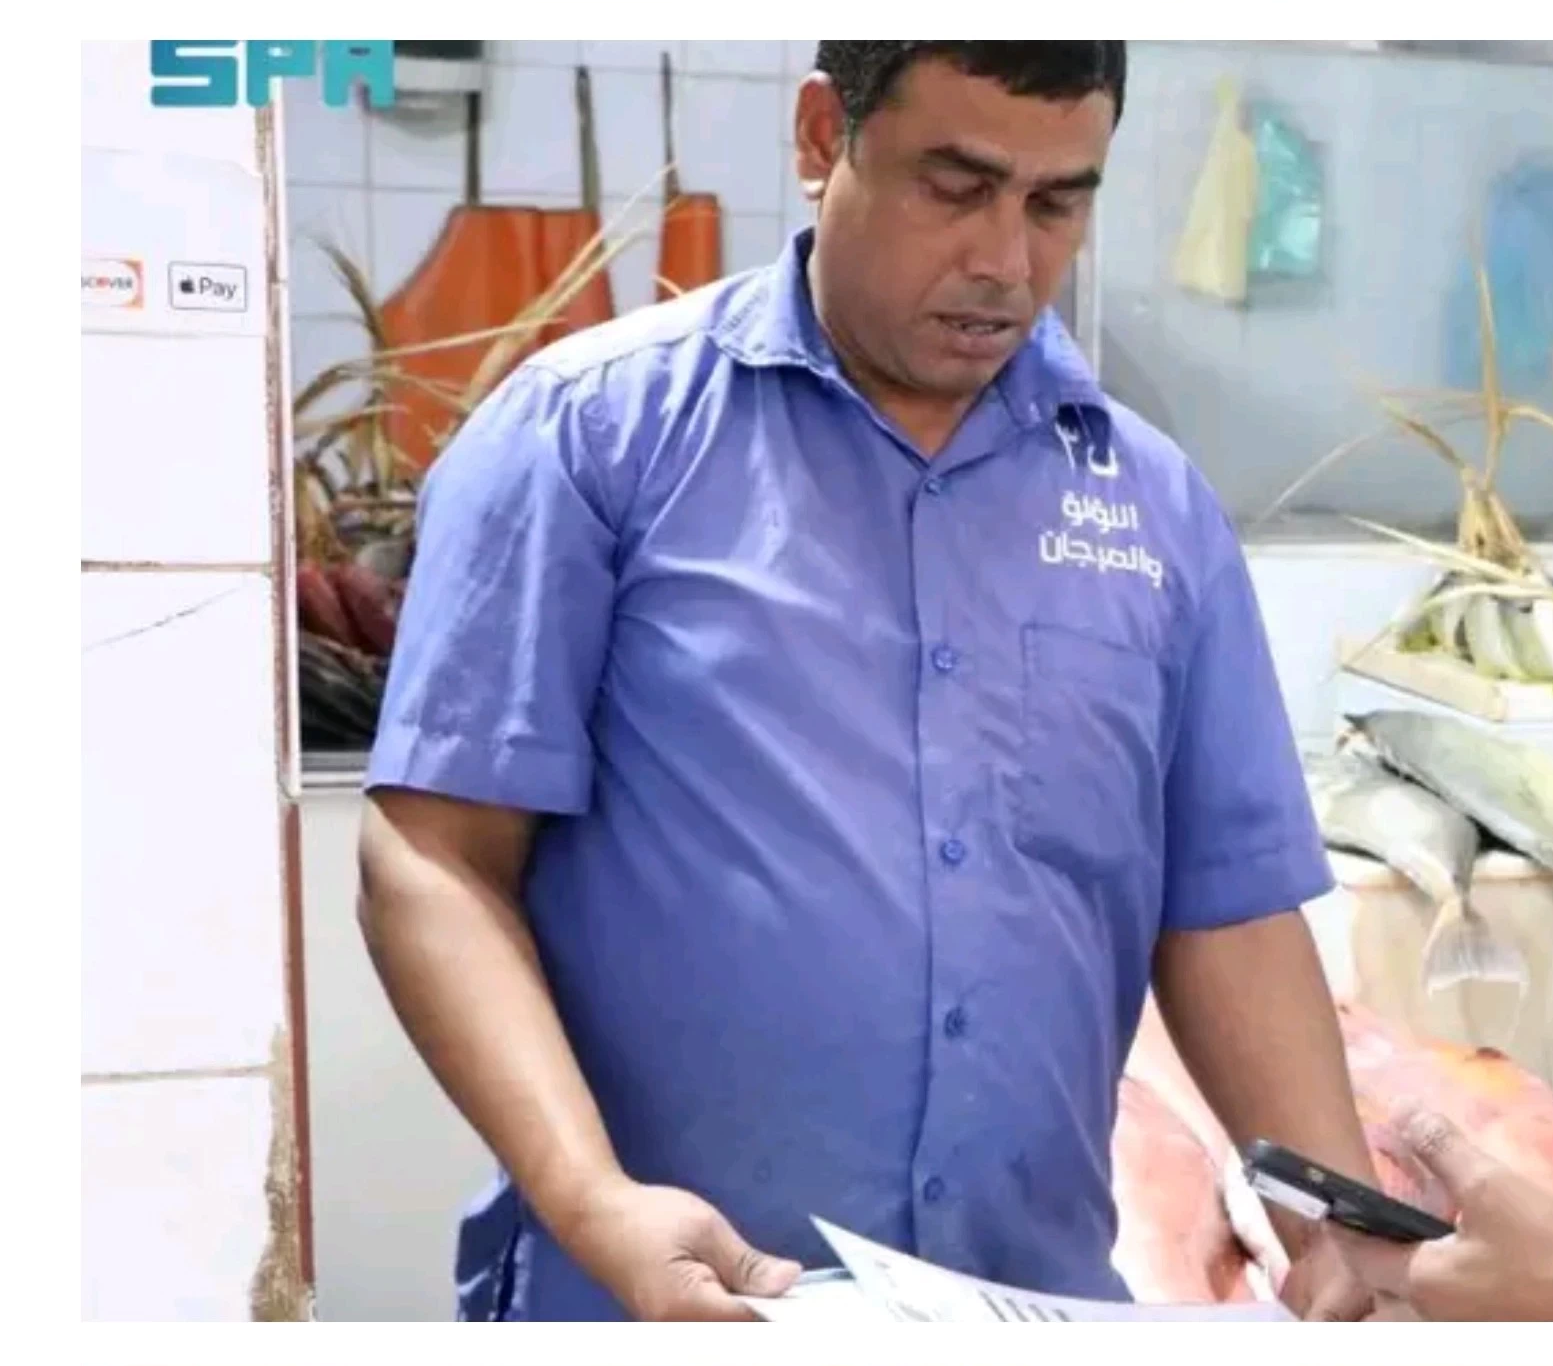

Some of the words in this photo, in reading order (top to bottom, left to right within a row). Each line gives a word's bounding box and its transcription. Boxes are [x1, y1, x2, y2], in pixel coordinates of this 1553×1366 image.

[199, 276, 237, 300] Pay
[1062, 489, 1138, 533] اللؤلؤ
[1039, 530, 1162, 588] والمرجان
